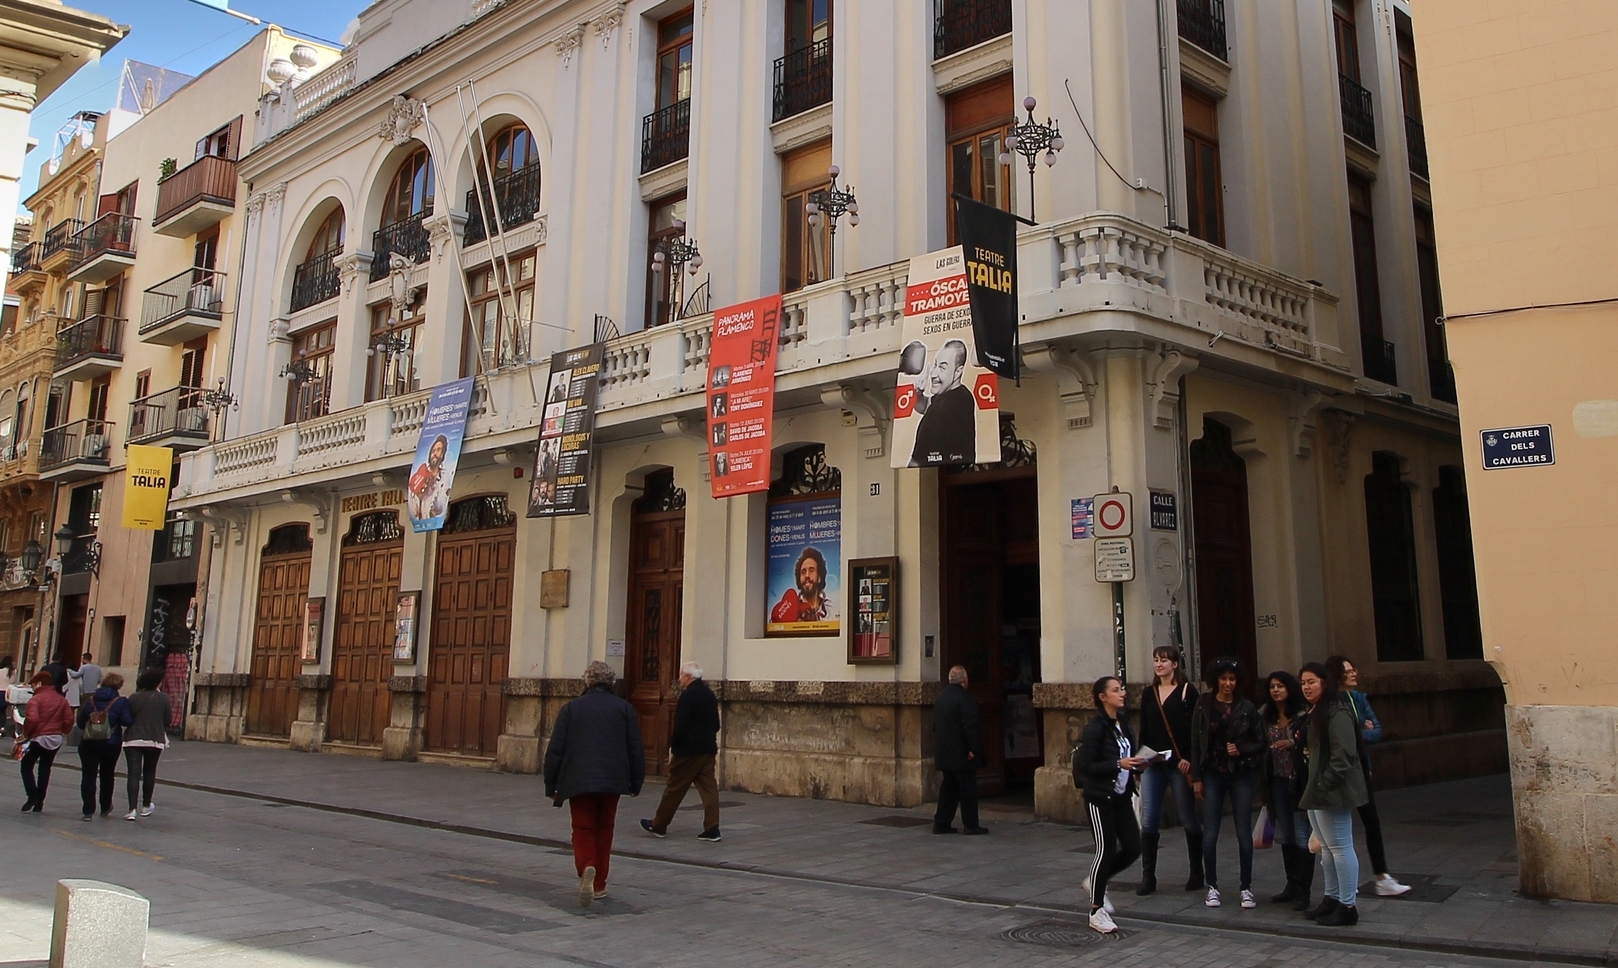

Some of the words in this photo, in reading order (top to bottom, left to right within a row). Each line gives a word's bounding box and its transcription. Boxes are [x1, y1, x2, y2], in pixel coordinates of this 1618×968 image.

[936, 258, 945, 269] LAS
[975, 247, 1004, 267] TEATRE
[967, 261, 1012, 295] TALIA
[931, 278, 968, 296] ÓSCA
[718, 310, 754, 327] PANORAMA
[924, 312, 946, 325] GUERRA
[947, 310, 955, 320] DE
[955, 308, 972, 319] SEXO
[717, 320, 754, 337] FLAMENCO
[923, 322, 942, 335] SEXOS
[943, 321, 951, 332] EN
[1503, 430, 1540, 439] CARRER
[1511, 442, 1535, 451] DELS
[1493, 455, 1547, 465] CAVALLERS
[132, 475, 166, 488] TALIA
[870, 484, 879, 494] 31
[341, 492, 378, 513] TEATRE
[1153, 495, 1173, 506] CALLE
[809, 520, 838, 529] HOMBRES
[771, 534, 790, 543] DONES
